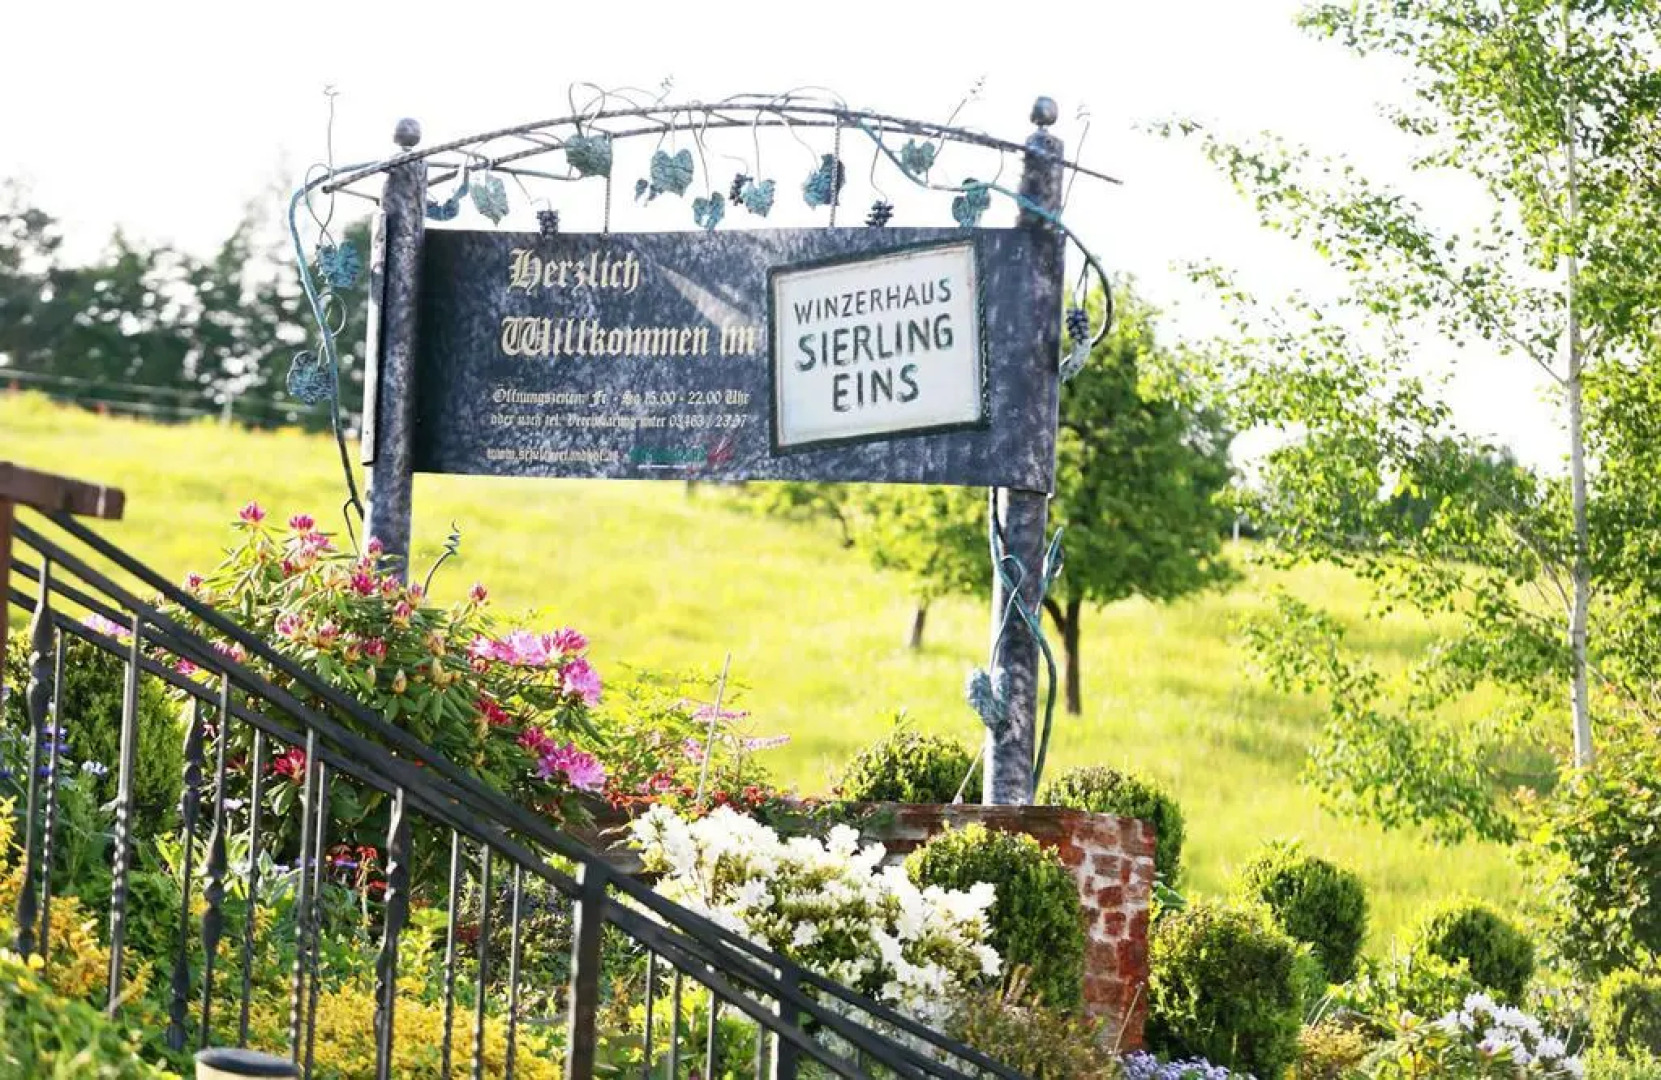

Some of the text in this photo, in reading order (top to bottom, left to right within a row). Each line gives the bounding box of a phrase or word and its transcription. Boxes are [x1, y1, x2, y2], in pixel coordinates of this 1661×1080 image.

[507, 248, 640, 295] Herzlich
[794, 278, 952, 325] WINZERHAUS
[501, 316, 710, 356] Willkommen
[795, 313, 953, 371] SIERLING
[687, 390, 722, 405] 22.00
[725, 389, 750, 405] Uhr
[832, 363, 919, 412] EINS
